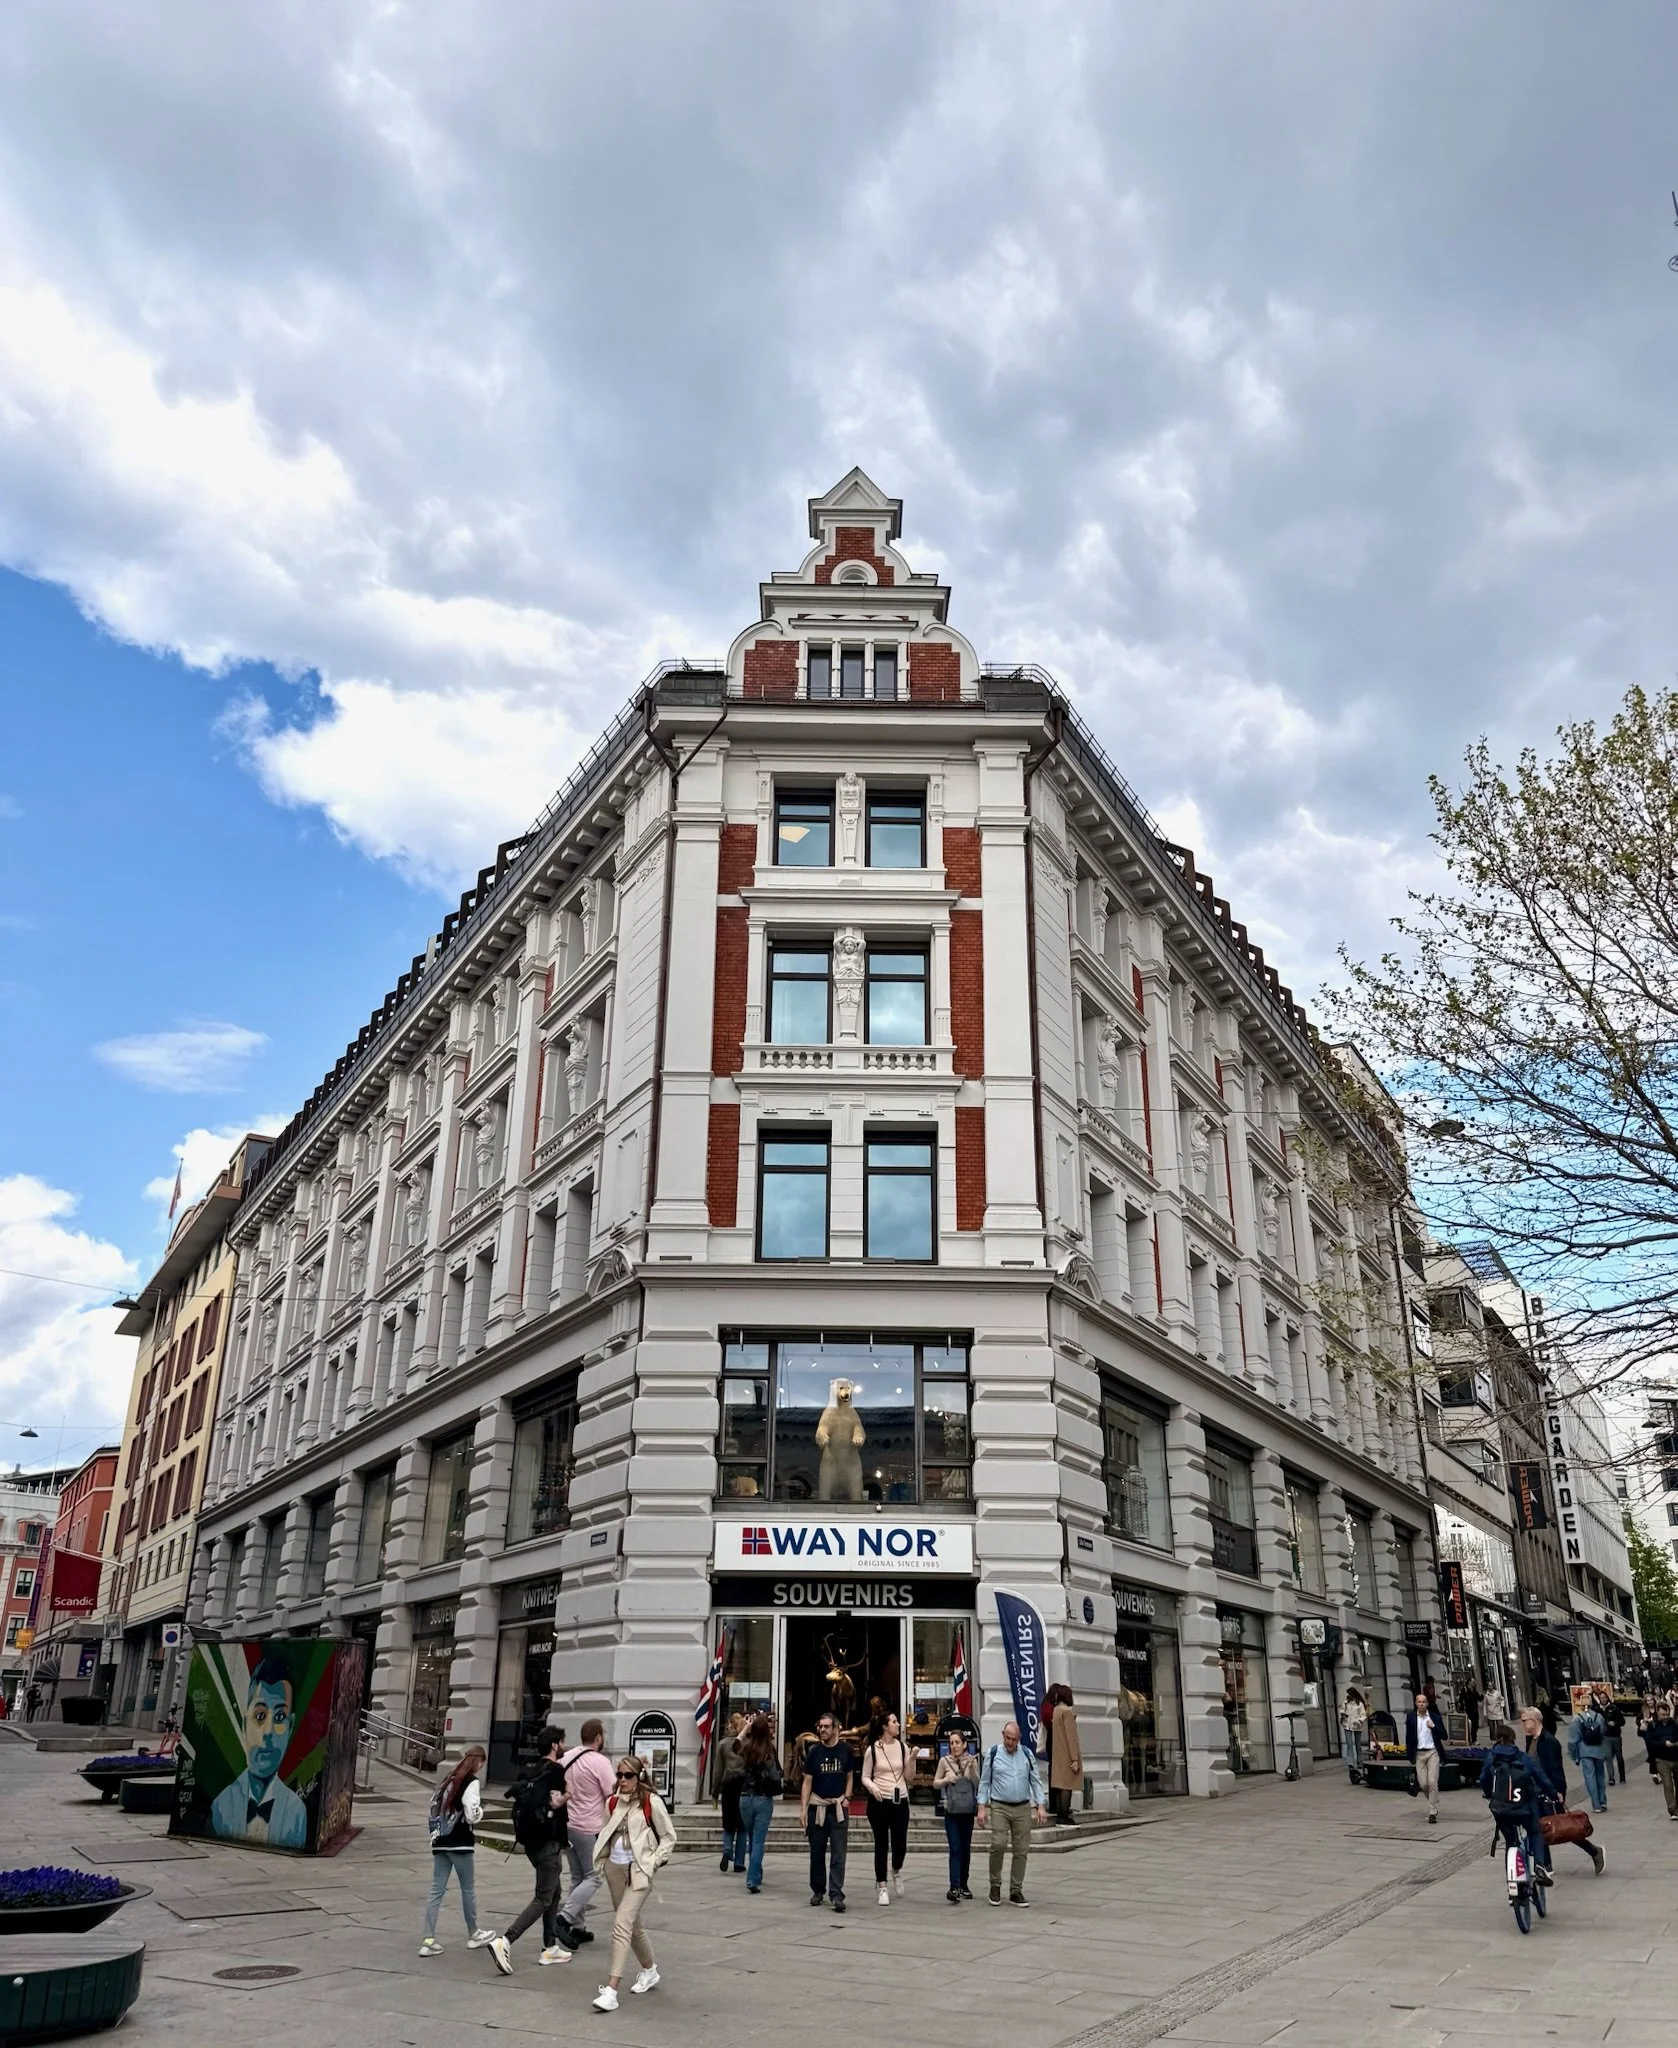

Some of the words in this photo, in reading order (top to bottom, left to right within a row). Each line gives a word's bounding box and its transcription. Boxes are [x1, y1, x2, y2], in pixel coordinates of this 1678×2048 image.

[858, 1560, 894, 1568] ORIGINAL
[897, 1560, 920, 1568] SINCE
[54, 1596, 94, 1606] Scandic
[773, 1583, 914, 1607] SOUVENIRS
[1112, 1590, 1156, 1616] OUVENIRS
[1451, 1566, 1463, 1623] POWER
[1513, 1788, 1521, 1802] S
